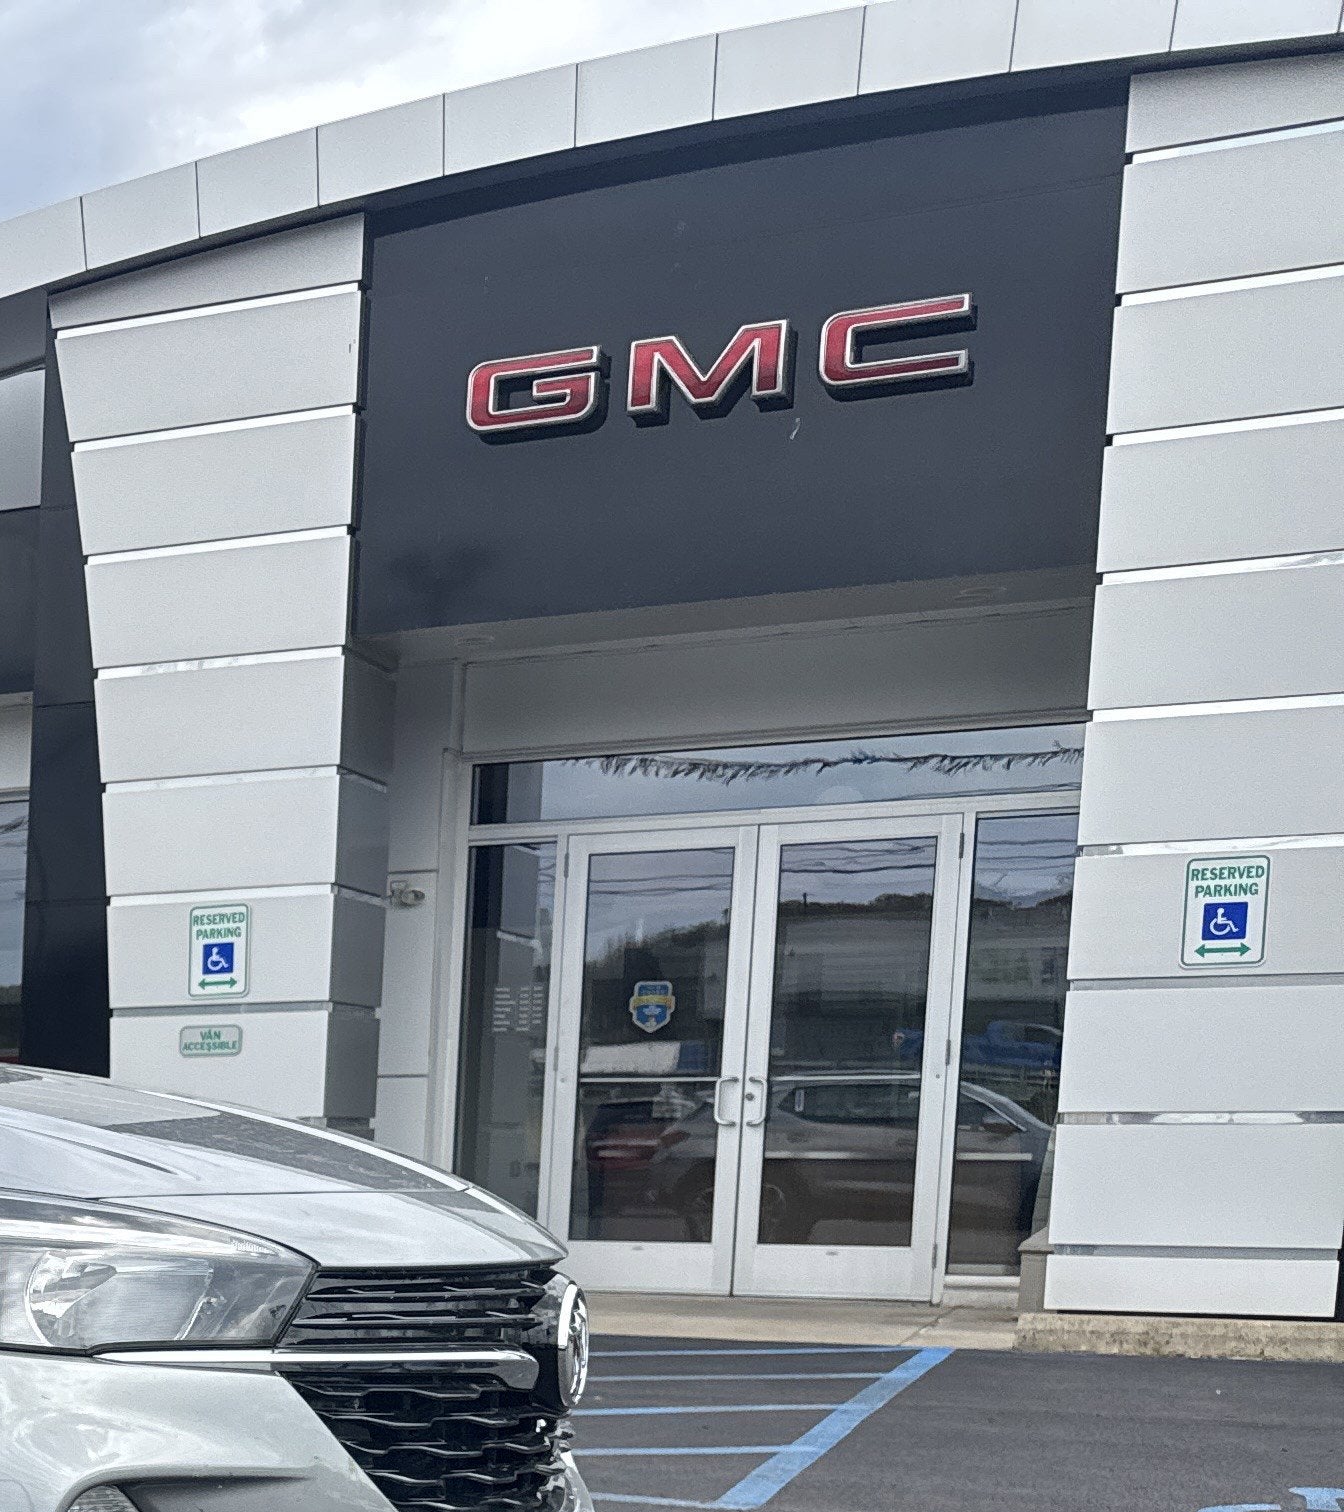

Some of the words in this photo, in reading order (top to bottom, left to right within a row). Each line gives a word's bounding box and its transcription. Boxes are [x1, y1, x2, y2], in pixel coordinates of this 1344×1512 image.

[465, 292, 974, 434] GMC
[1191, 866, 1265, 881] RESERVED
[1194, 883, 1259, 898] PARKING
[193, 912, 245, 926] RESERVED
[196, 927, 242, 940] PARKING
[200, 1031, 221, 1041] VAN
[183, 1041, 237, 1051] ACCESSIBLE
